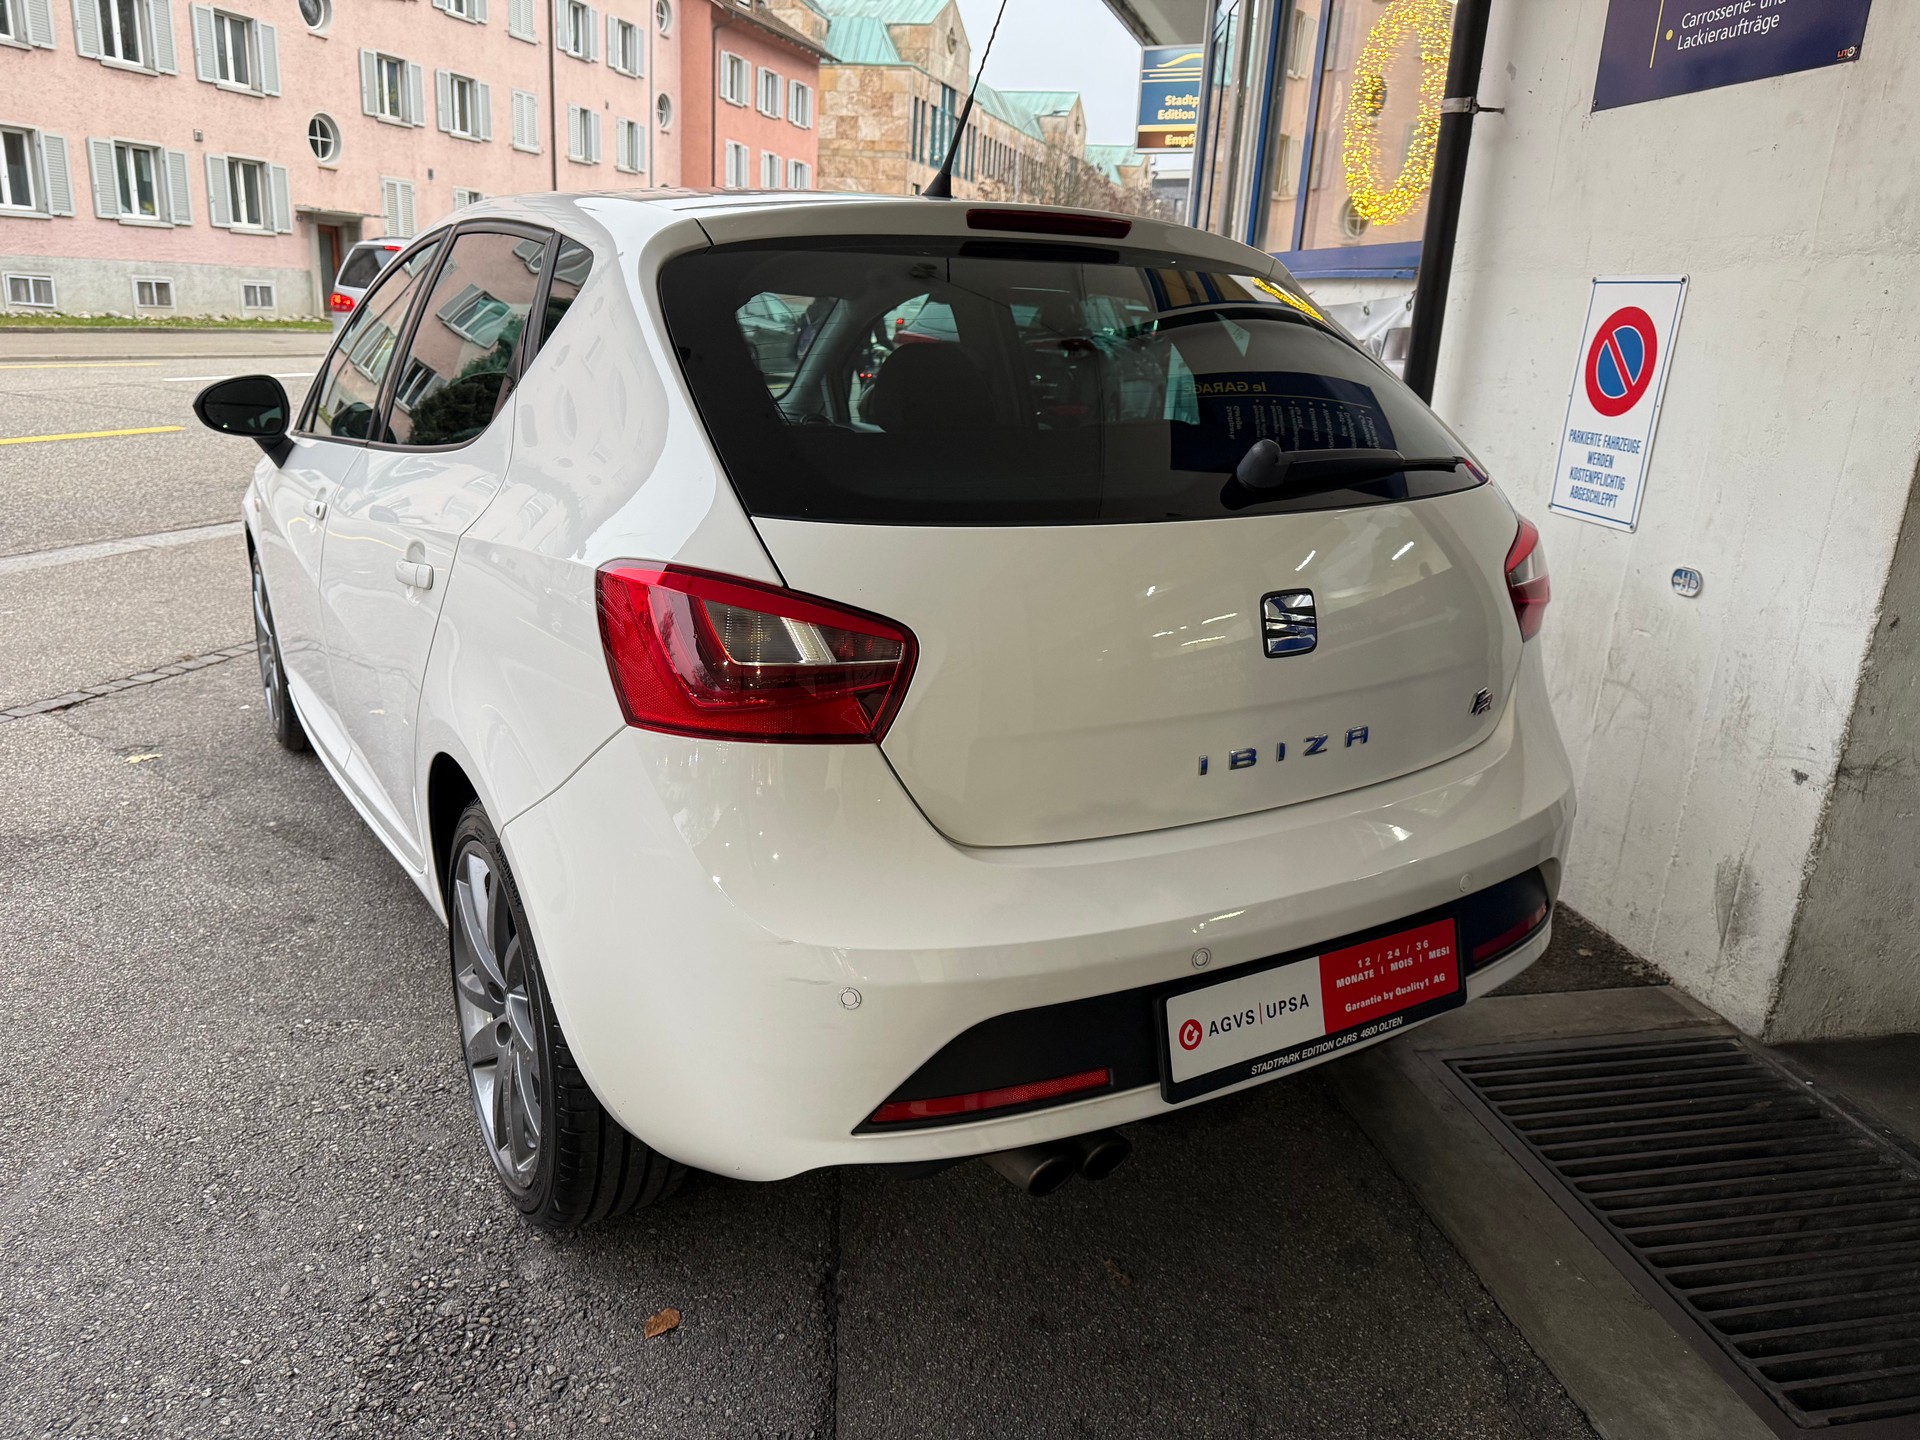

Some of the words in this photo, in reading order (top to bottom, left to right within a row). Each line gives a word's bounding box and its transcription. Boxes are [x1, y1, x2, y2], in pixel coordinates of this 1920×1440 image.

[1681, 0, 1756, 29] Carrosserie-
[1677, 14, 1780, 51] Lackieraufträge
[1157, 109, 1196, 120] Edition
[1568, 429, 1602, 447] PARKIERTE
[1603, 434, 1642, 454] FAHRZEUGE
[1587, 451, 1615, 469] WERDEN
[1569, 466, 1626, 490] KOSTENPFLICHTIG
[1569, 485, 1618, 508] ABGESCHLEPPT
[1198, 724, 1370, 776] IBIZA
[1336, 969, 1375, 988] MONATE
[1390, 957, 1413, 972] MOIS
[1428, 946, 1450, 959] MESI
[1357, 957, 1371, 968] 12
[1387, 948, 1401, 959] 24
[1415, 940, 1429, 951] 36
[1383, 991, 1394, 1001] by
[1395, 978, 1429, 996] Quality1
[1433, 973, 1446, 984] AG
[1208, 1009, 1255, 1037] AGVS
[1266, 993, 1310, 1019] UPSA
[1251, 1051, 1301, 1075] STADTPARK
[1302, 1040, 1335, 1059] EDITION
[1335, 1032, 1358, 1047] CARS
[1360, 1025, 1378, 1038] 4800
[1378, 1016, 1403, 1033] OLTEN
